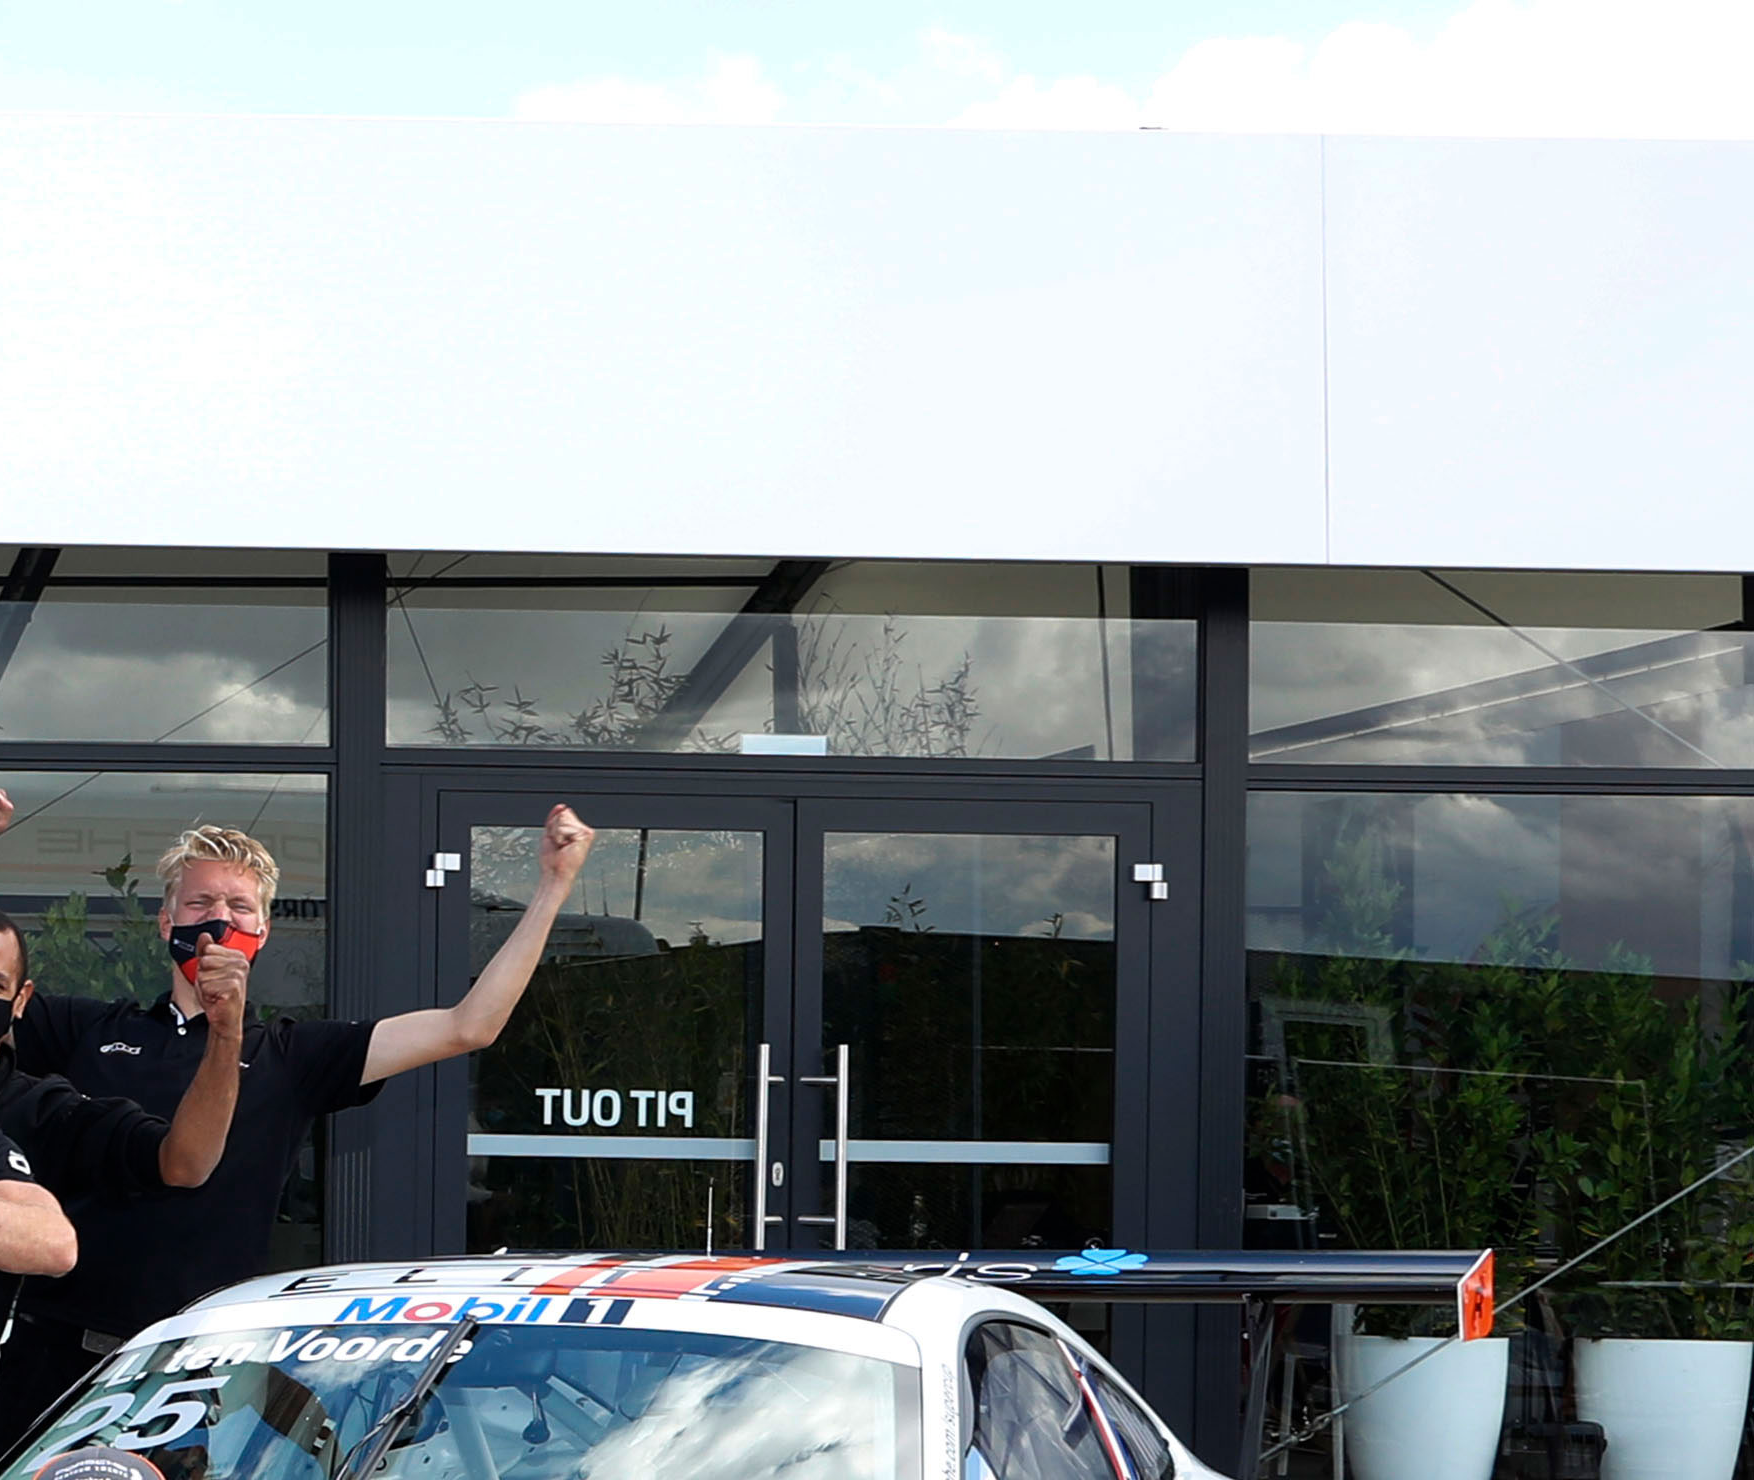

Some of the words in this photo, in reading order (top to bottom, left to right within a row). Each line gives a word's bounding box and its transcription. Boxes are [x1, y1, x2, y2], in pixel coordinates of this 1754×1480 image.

[903, 1252, 1039, 1281] ris
[333, 1295, 552, 1324] Mobil
[561, 1297, 631, 1324] 1
[164, 1341, 259, 1374] ten
[267, 1328, 475, 1365] Voorde
[19, 1375, 232, 1476] 25
